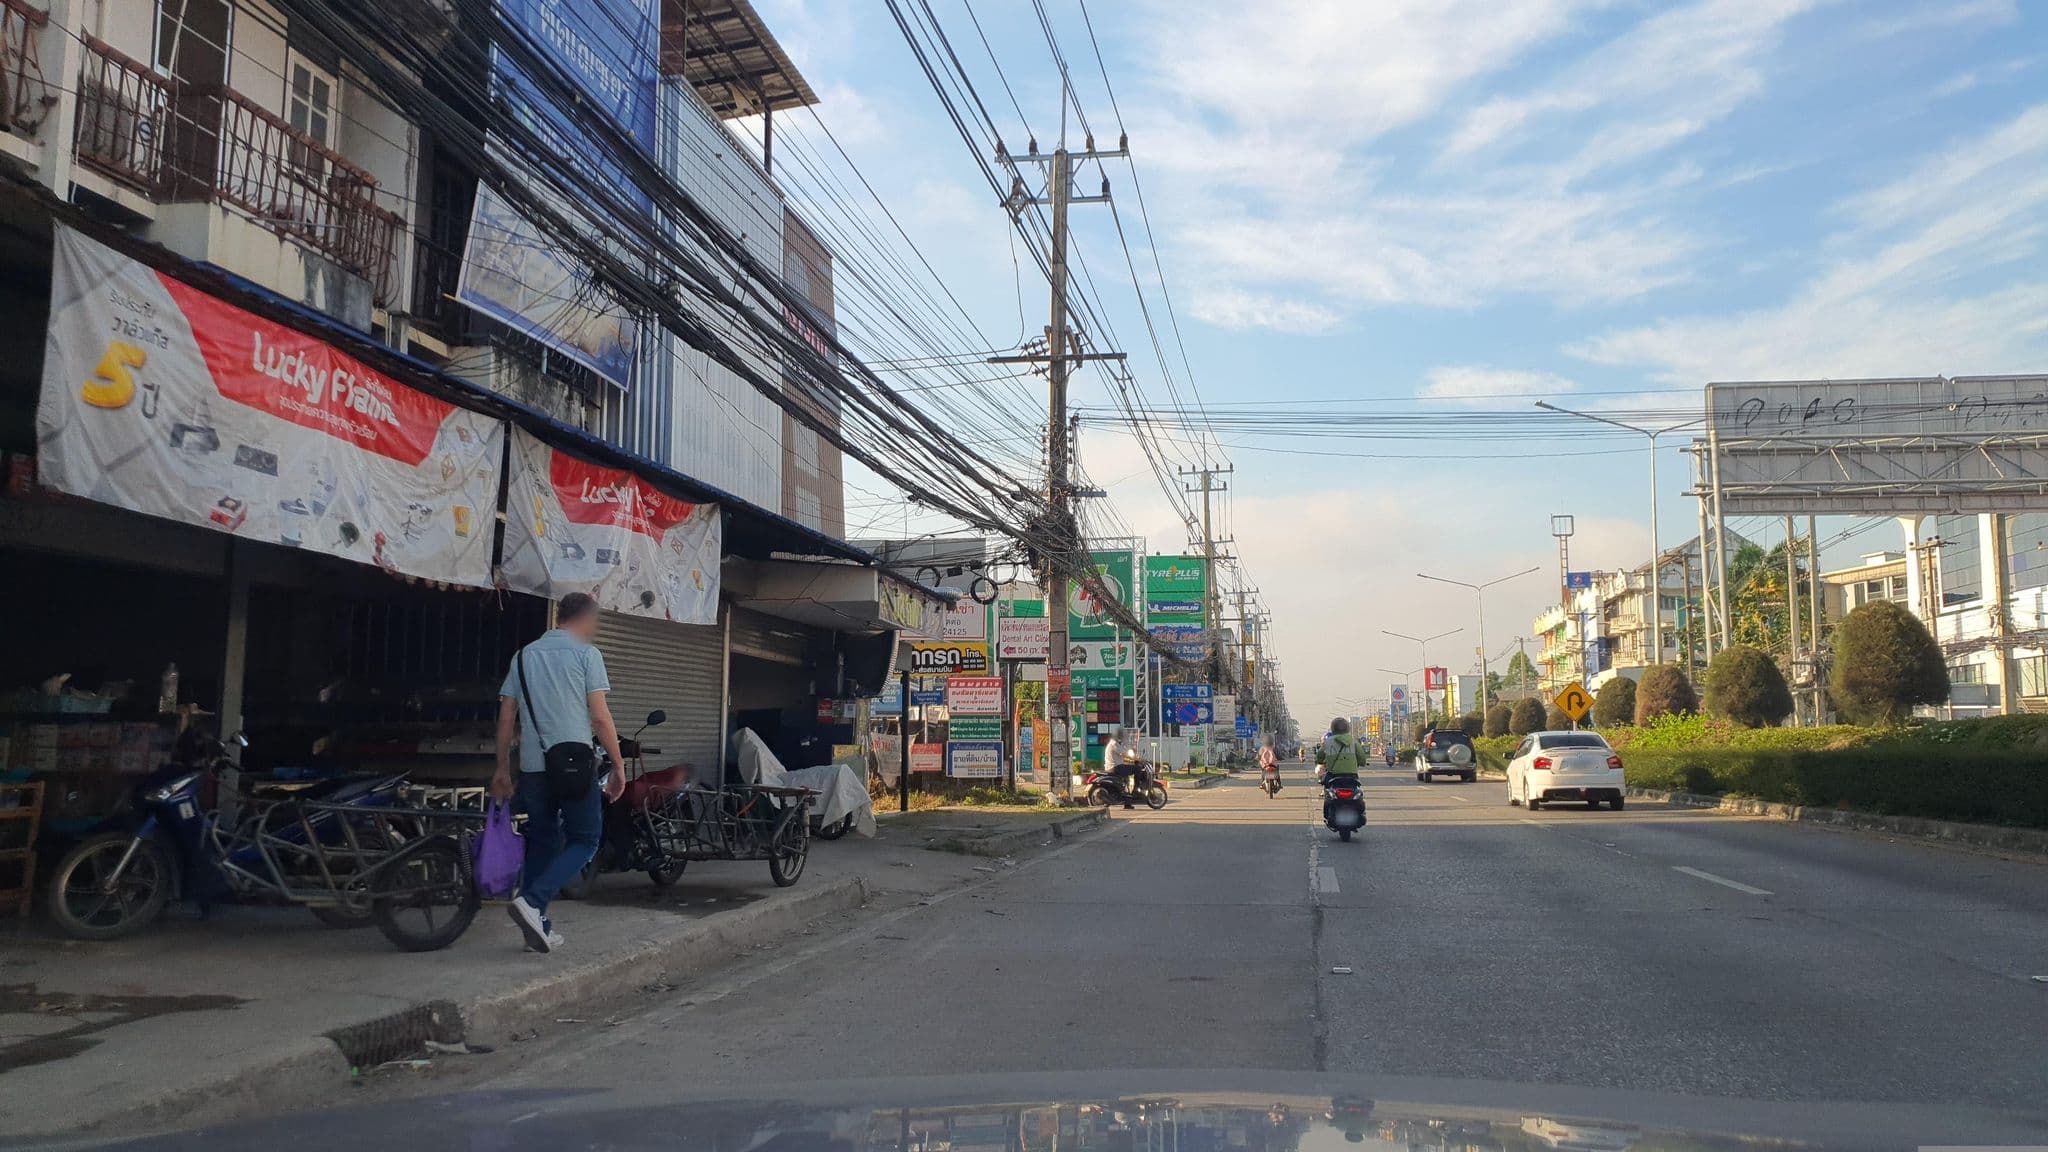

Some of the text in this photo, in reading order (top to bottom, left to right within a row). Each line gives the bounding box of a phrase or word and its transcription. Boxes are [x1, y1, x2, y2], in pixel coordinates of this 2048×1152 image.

[82, 341, 147, 408] 5
[253, 330, 327, 404] Lucky
[141, 383, 161, 418] ปี
[580, 476, 633, 512] Lucky
[1002, 634, 1021, 643] Dental
[1024, 635, 1033, 643] Art
